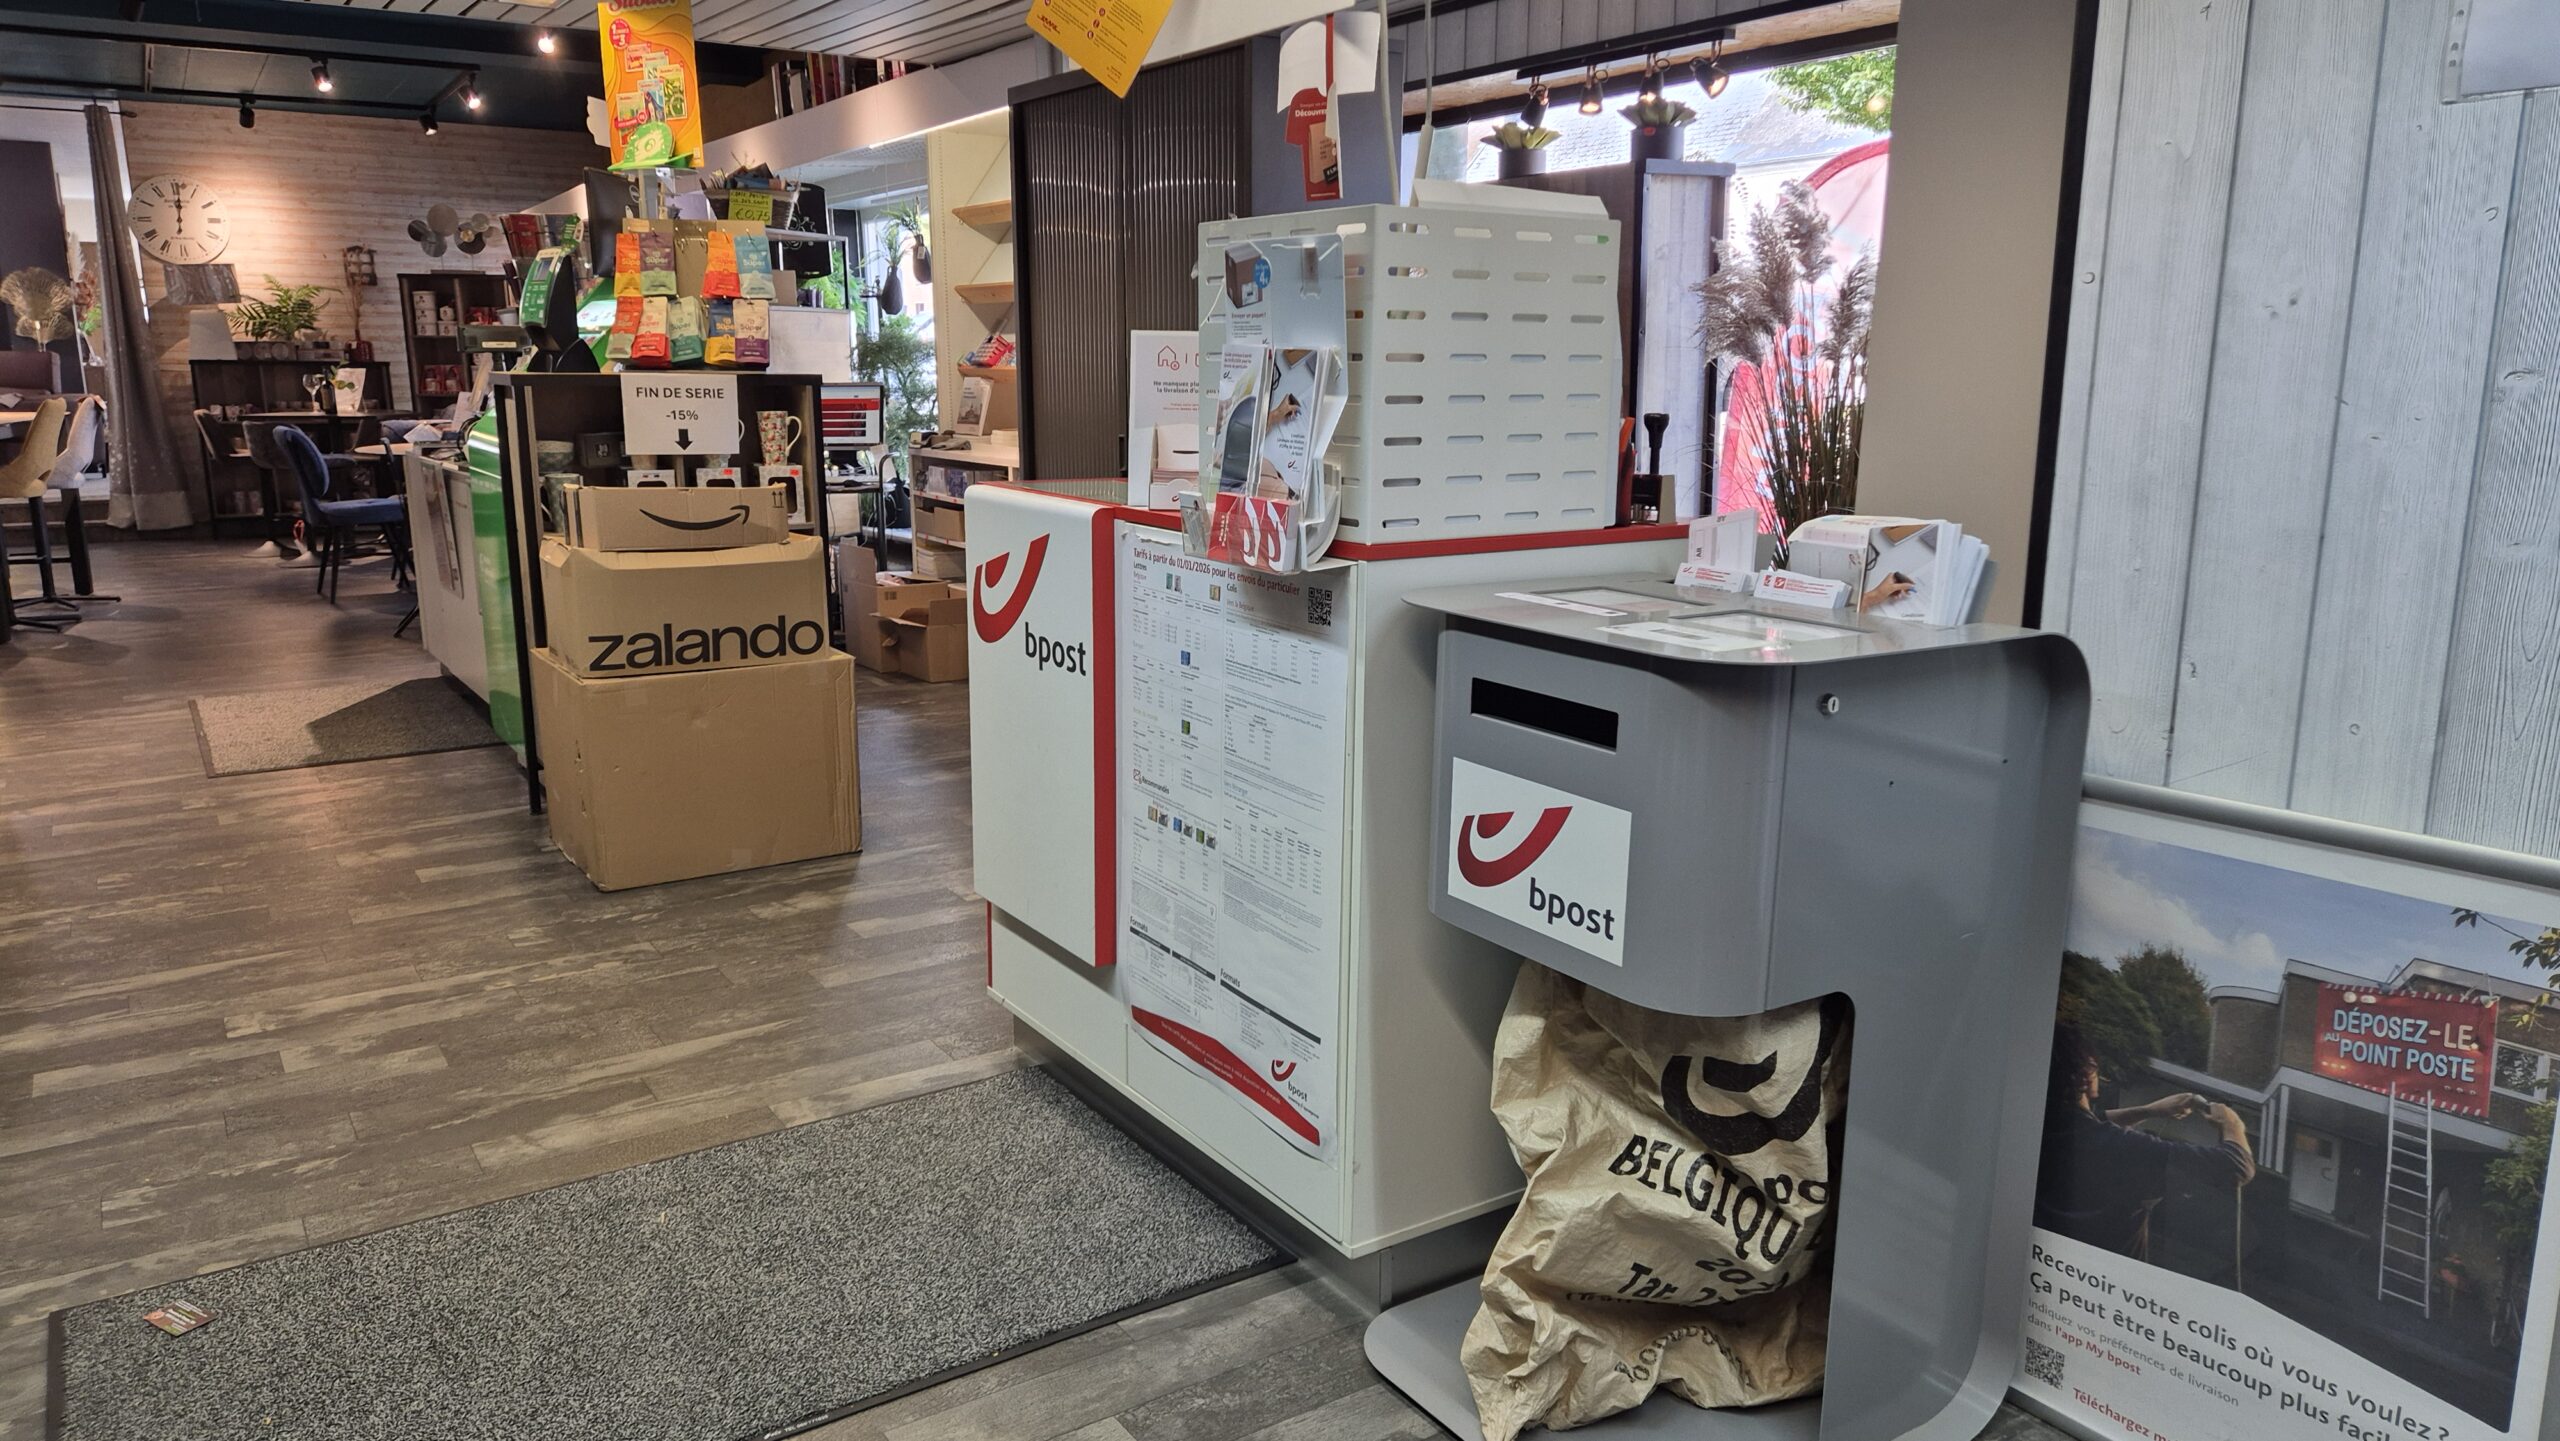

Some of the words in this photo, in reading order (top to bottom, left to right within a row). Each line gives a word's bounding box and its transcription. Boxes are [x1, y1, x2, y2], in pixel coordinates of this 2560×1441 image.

[636, 387, 659, 398] FIN
[663, 388, 682, 398] DE
[686, 388, 725, 399] SERIE
[666, 410, 699, 421] -15%
[1134, 548, 1147, 560] Tarifs
[1153, 553, 1167, 564] partir
[1168, 555, 1176, 567] du
[1177, 558, 1210, 574] 01/01/2026
[1212, 567, 1226, 579] pour
[1227, 568, 1236, 580] les
[1237, 573, 1256, 585] envois
[1257, 576, 1266, 587] du
[1267, 580, 1300, 596] particulier
[588, 615, 824, 672] zalando
[1025, 621, 1087, 676] bpost
[1130, 916, 1149, 933] Formats
[1529, 877, 1615, 941] bpost
[1220, 968, 1241, 988] Formats
[2324, 1032, 2340, 1043] AU
[2334, 1007, 2474, 1051] DÉPOSEZ-LE
[2339, 1038, 2402, 1069] POINT
[2407, 1048, 2476, 1083] POSTE
[1288, 1081, 1308, 1102] bpost
[1608, 1134, 1801, 1267] BELGIQU
[2028, 1313, 2052, 1333] dans
[2055, 1326, 2083, 1349] l'app
[2085, 1341, 2104, 1360] My
[2107, 1349, 2141, 1376] bpost
[2028, 1299, 2073, 1327] Indiquez
[2077, 1322, 2096, 1338] vos
[2100, 1333, 2167, 1372] préférences
[2169, 1364, 2184, 1381] de
[2188, 1373, 2240, 1407] livraison
[2030, 1272, 2052, 1295] Ça
[2059, 1287, 2106, 1320] peut
[2113, 1309, 2156, 1342] être
[2163, 1330, 2273, 1400] beaucoup
[2280, 1391, 2329, 1425] plus
[2032, 1244, 2116, 1295] Recevoir
[2122, 1288, 2180, 1325] votre
[2187, 1317, 2237, 1352] colis
[2244, 1346, 2274, 1369] où
[2282, 1360, 2338, 1397] vous
[2347, 1390, 2432, 1441] voulez
[2073, 1387, 2151, 1438] Téléchargez
